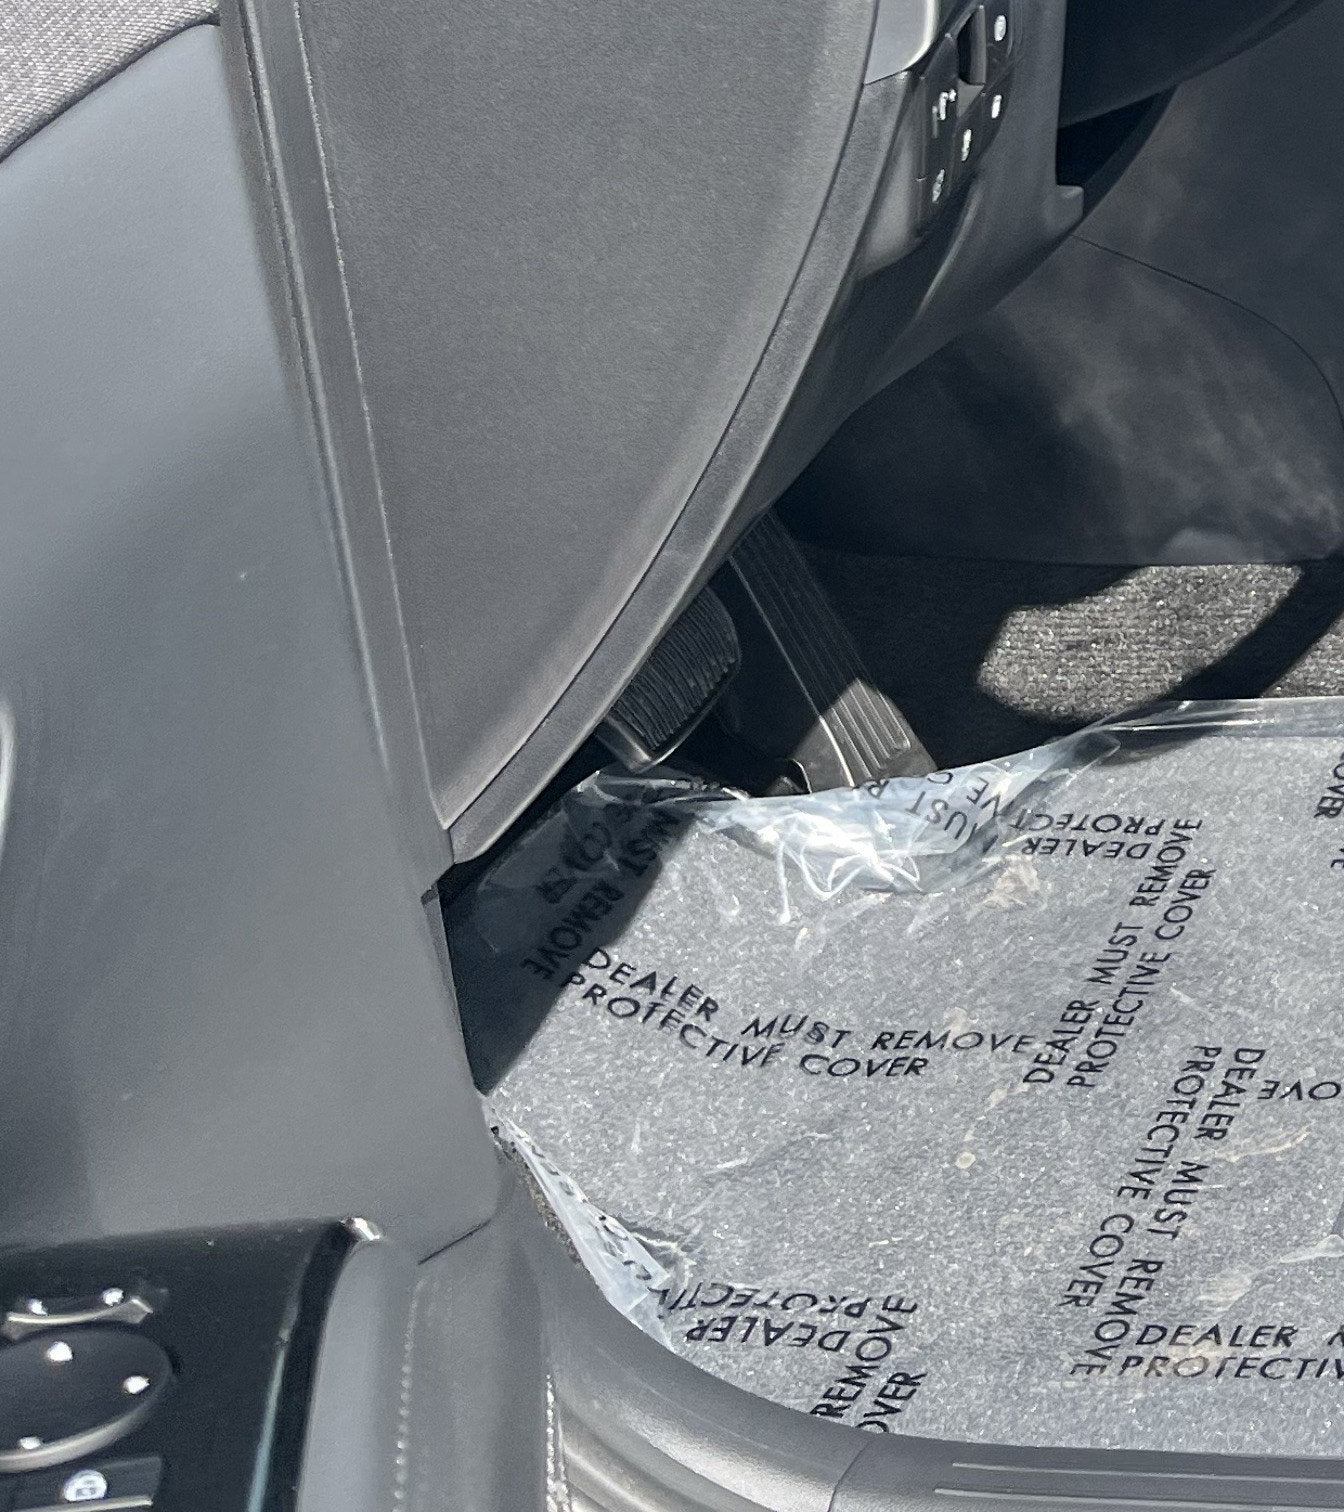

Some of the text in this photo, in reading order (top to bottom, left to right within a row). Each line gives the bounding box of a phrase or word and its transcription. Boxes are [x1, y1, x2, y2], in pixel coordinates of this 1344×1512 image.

[1021, 838, 1152, 859] DEALER
[580, 947, 1036, 1054] DEALER MUST REMOVE
[1022, 818, 1203, 1084] DEALER MUST REMOVE
[1066, 868, 1217, 1088] PROTECTIVE COVER
[561, 971, 929, 1078] PROTECTIVE COVER
[1058, 1045, 1223, 1309] PROTECTIVE COVER
[1069, 1047, 1266, 1376] DEALER MUST REMOVE
[685, 1314, 851, 1353] DEALER
[809, 1295, 919, 1419] REMOVE
[1135, 1323, 1300, 1349] DEALER
[855, 1372, 929, 1433] OVER
